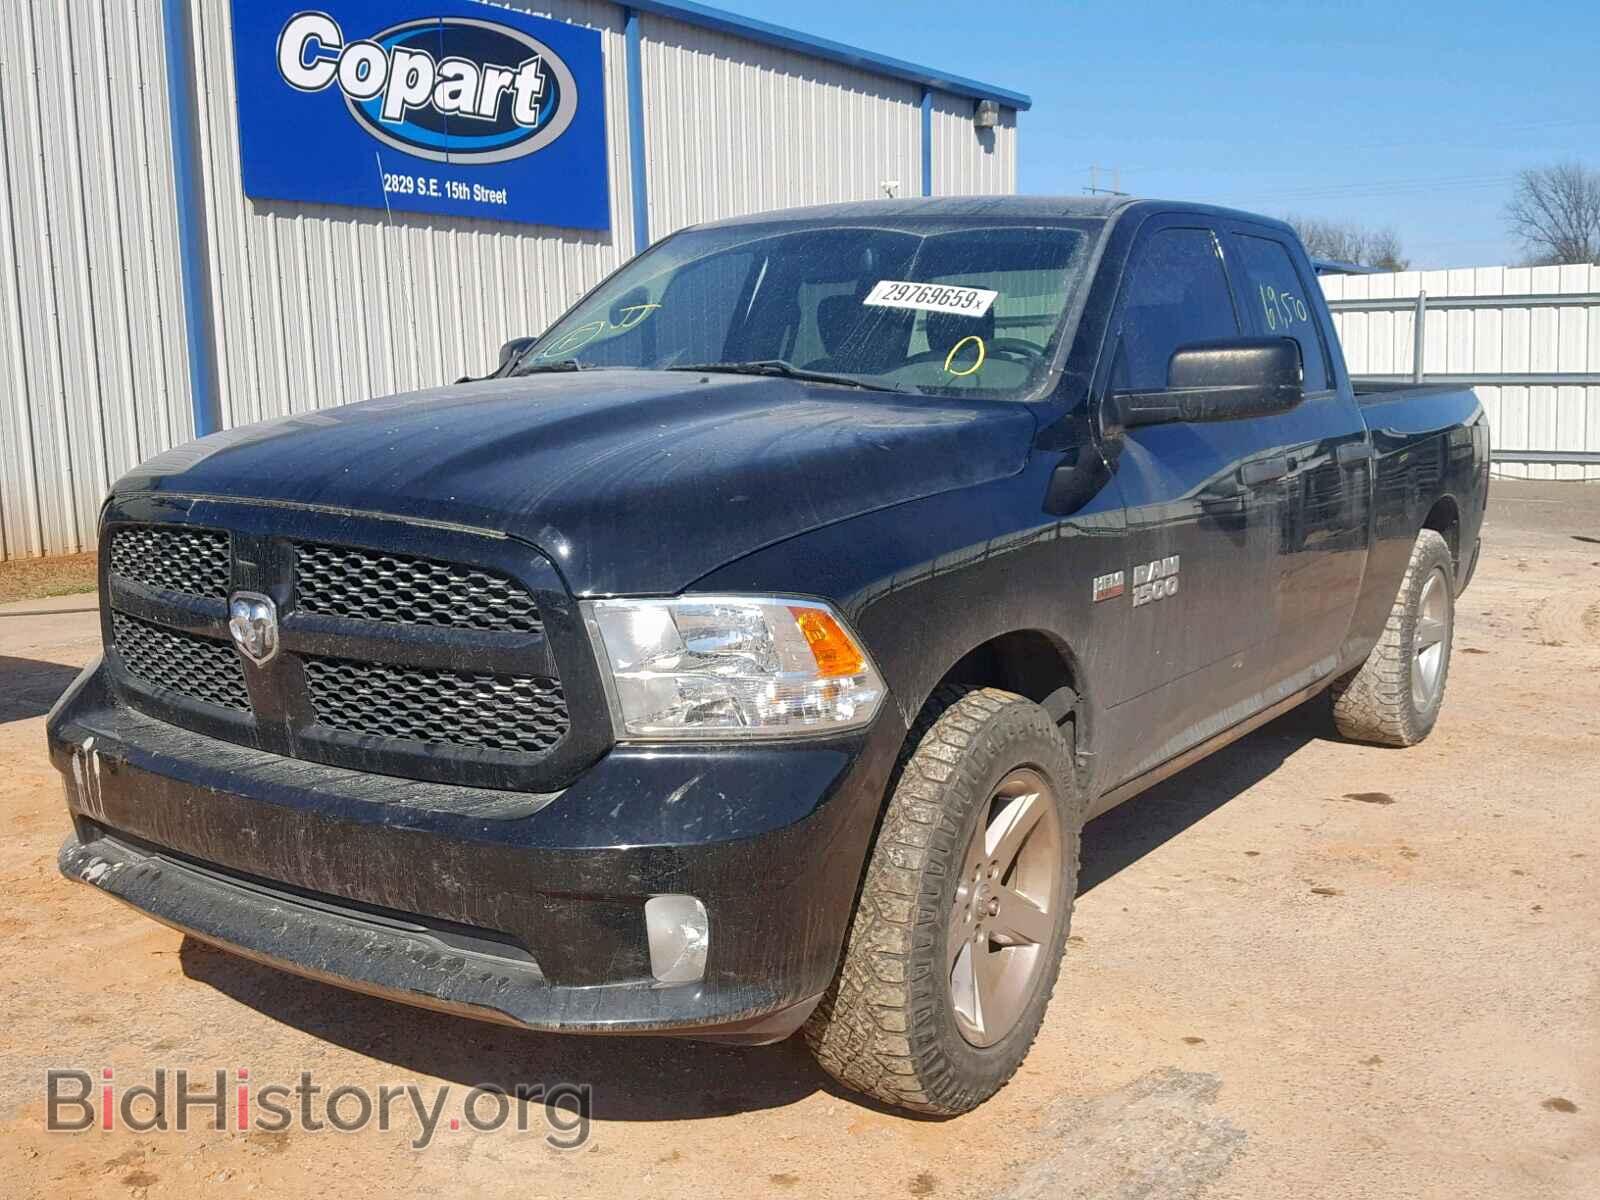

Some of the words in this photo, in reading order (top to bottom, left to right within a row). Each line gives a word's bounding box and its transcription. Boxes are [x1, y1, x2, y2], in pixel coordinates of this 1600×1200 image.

[277, 11, 546, 127] Copart
[383, 173, 414, 194] 2829
[417, 177, 442, 197] S.E.
[445, 180, 471, 200] 15th
[473, 183, 508, 205] Street
[1133, 554, 1180, 586] RAM
